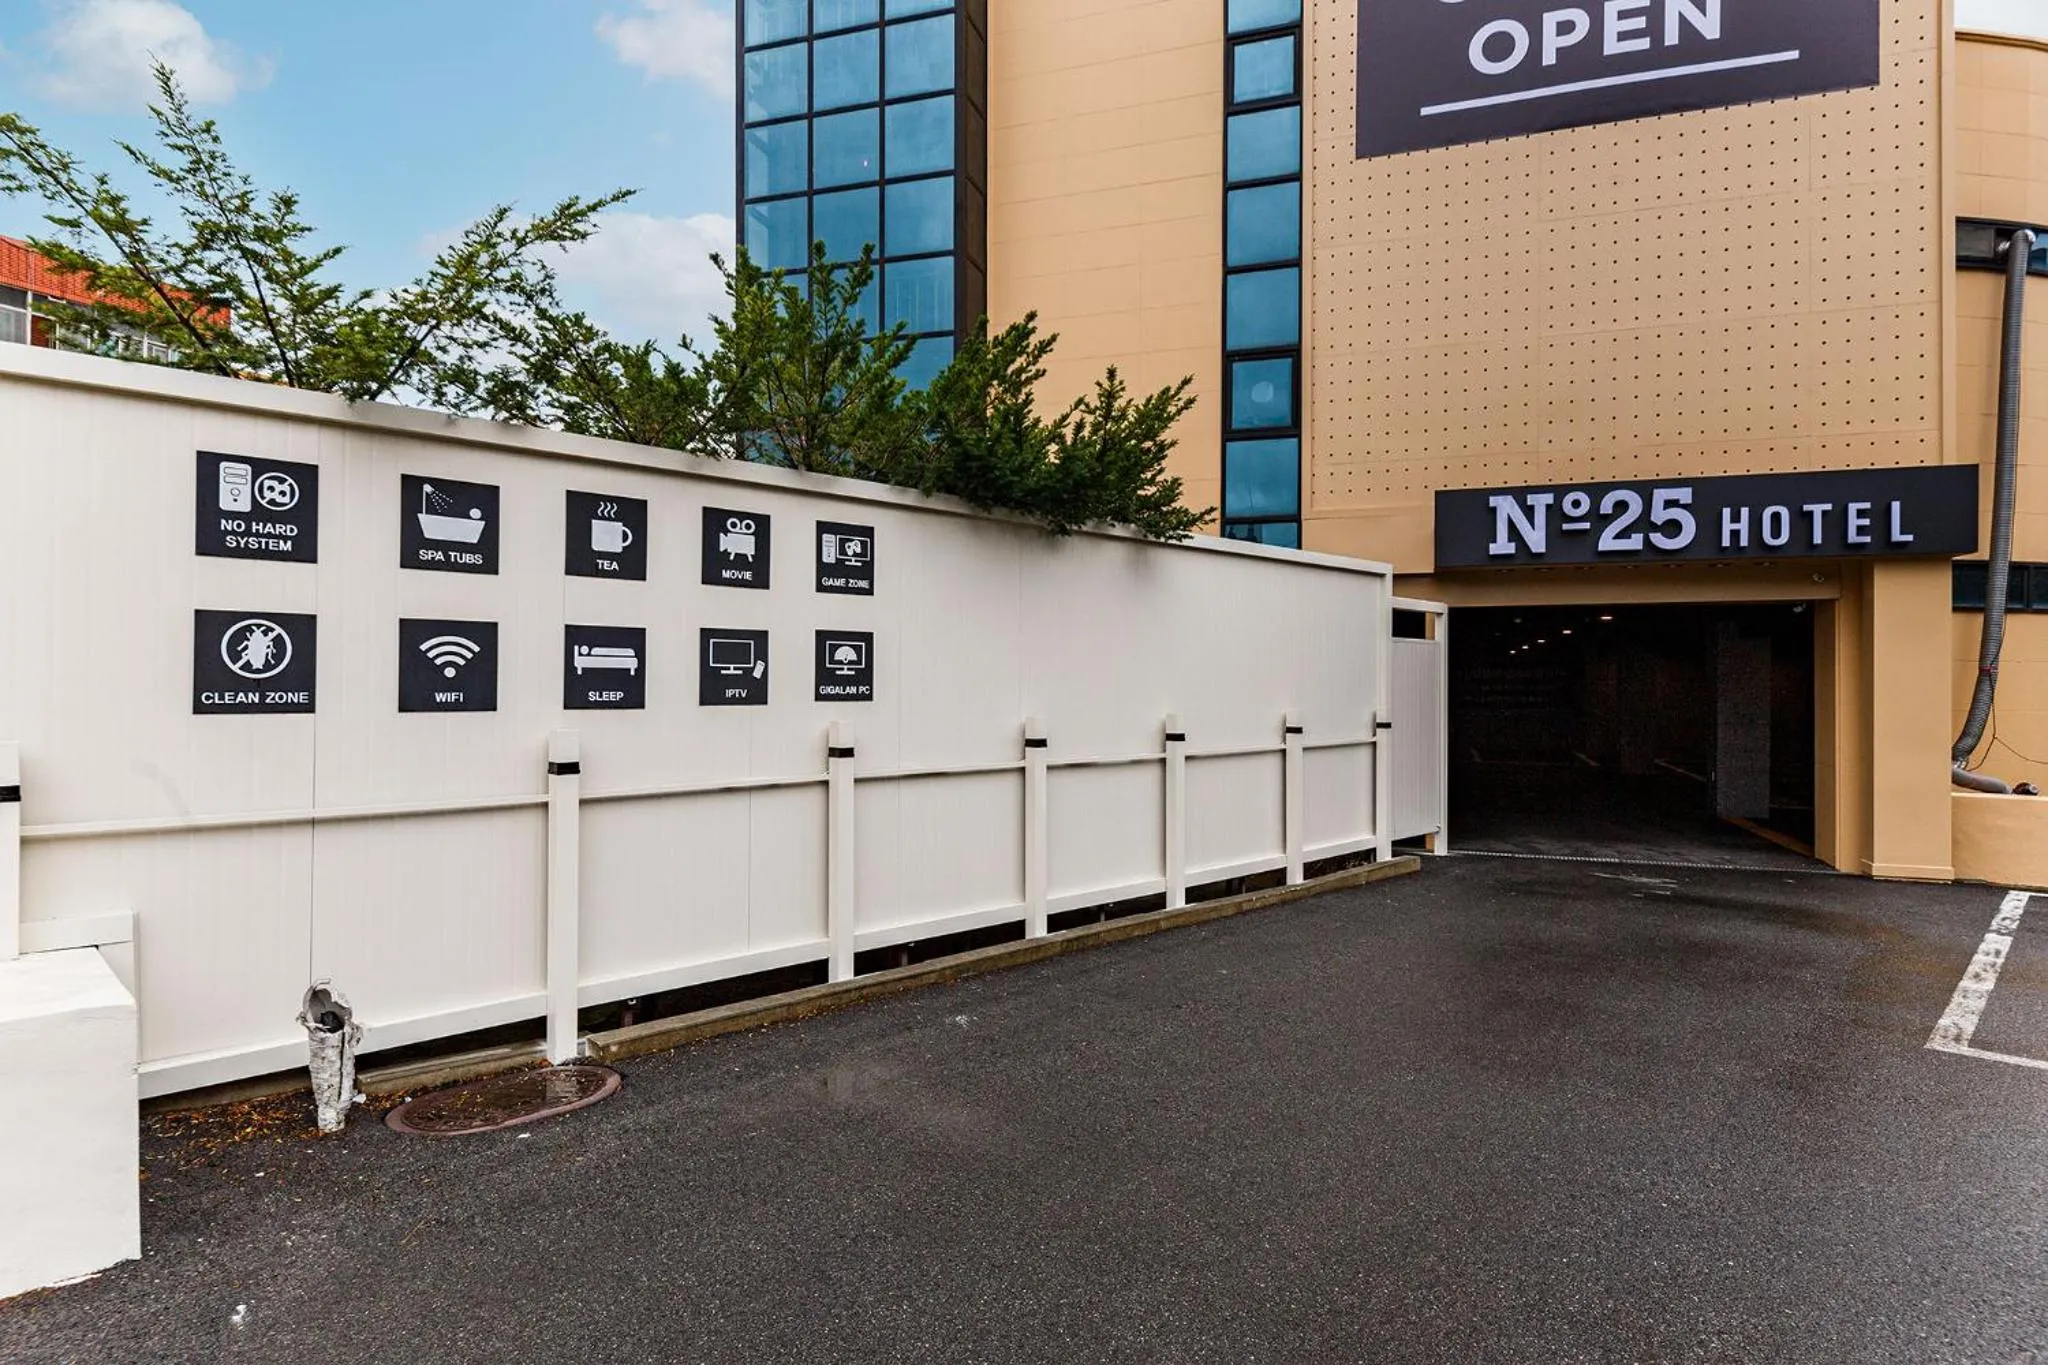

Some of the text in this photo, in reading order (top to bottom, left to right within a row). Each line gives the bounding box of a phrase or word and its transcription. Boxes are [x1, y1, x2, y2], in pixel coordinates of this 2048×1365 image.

[1468, 0, 1722, 76] OPEN
[220, 518, 298, 537] NO HARD
[1721, 500, 1914, 547] HOTEL
[225, 535, 293, 552] SYSTEM
[418, 549, 483, 565] SPA TUBS
[596, 559, 619, 571] TEA
[722, 569, 753, 581] MOVIE
[821, 576, 870, 589] GAME ZONE
[588, 691, 624, 701] SLEEP
[725, 688, 748, 698] IPTV
[818, 685, 871, 695] GIGALAN PC
[201, 691, 309, 704] CLEAN ZONE
[434, 692, 464, 703] WIFI
